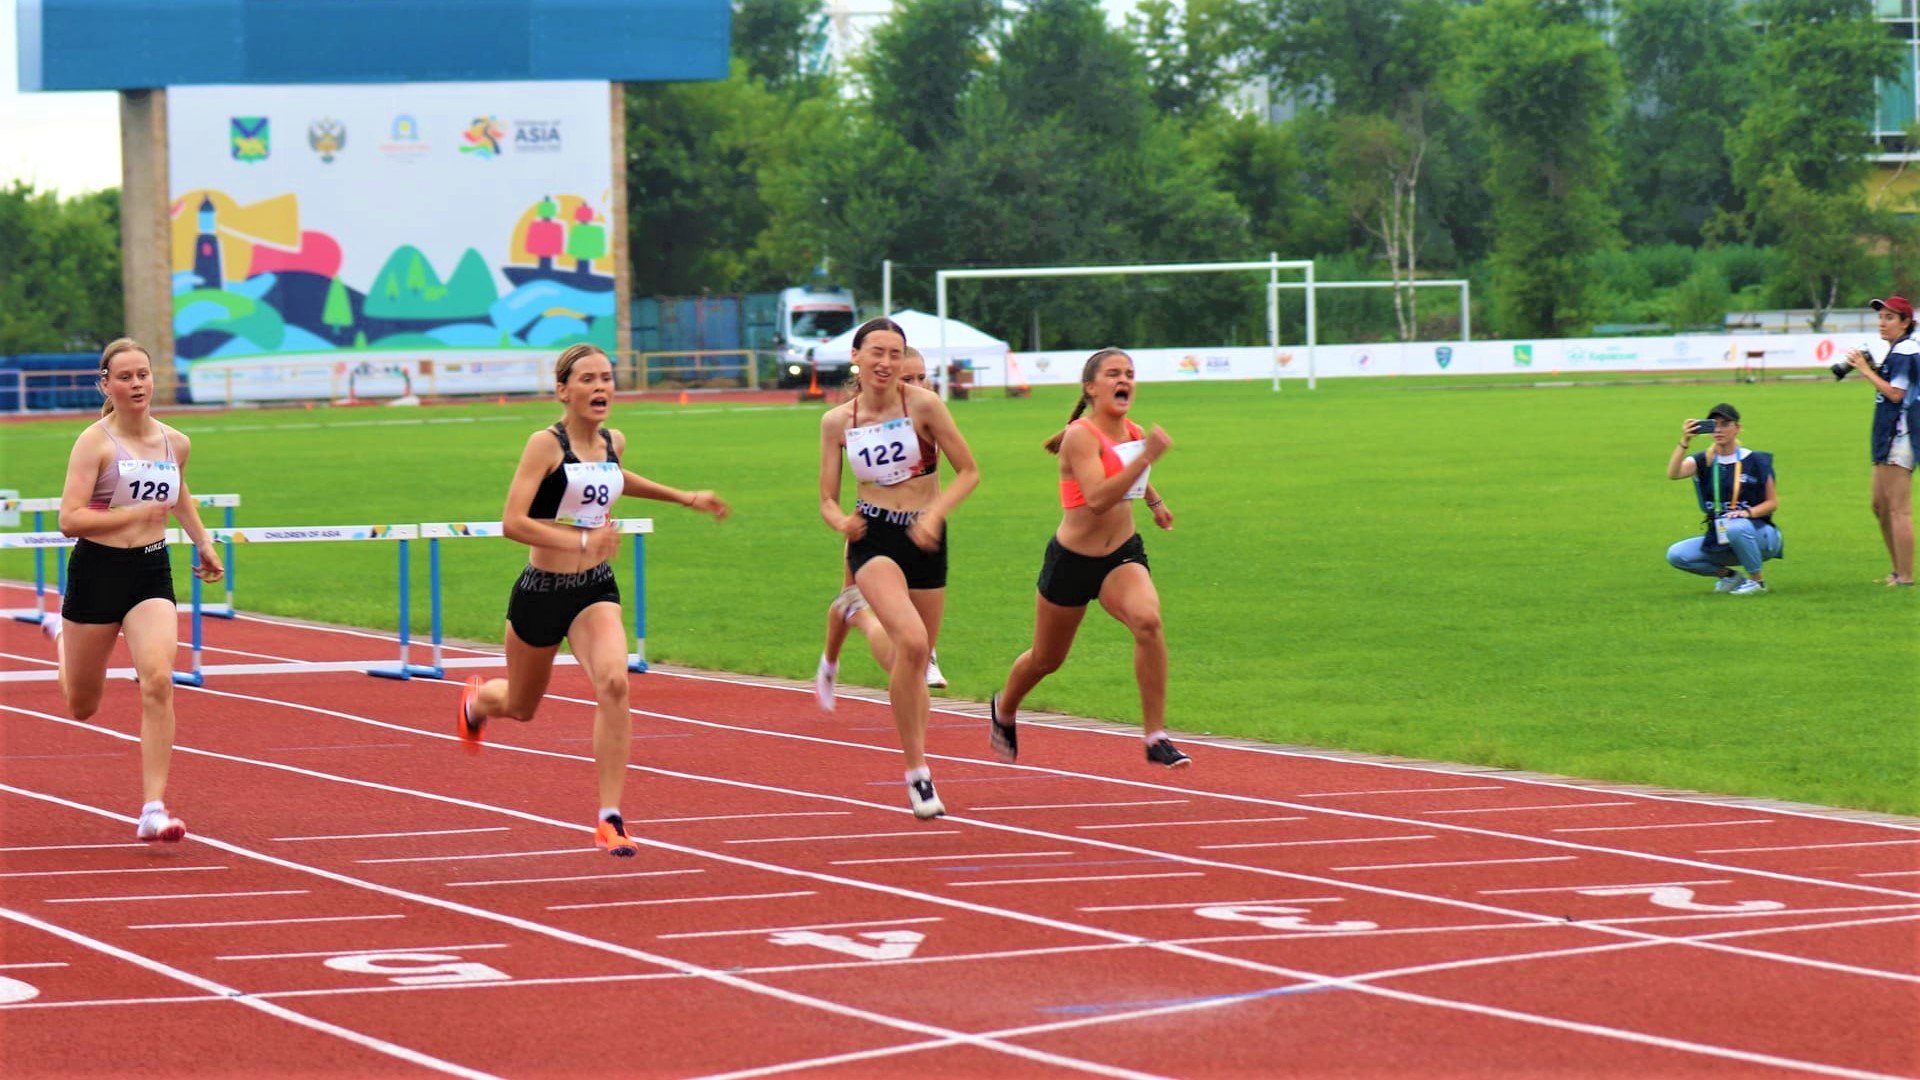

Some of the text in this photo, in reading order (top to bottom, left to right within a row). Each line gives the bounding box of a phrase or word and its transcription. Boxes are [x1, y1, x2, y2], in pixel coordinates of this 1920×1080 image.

[515, 127, 560, 142] ASIA
[858, 441, 906, 467] 122
[129, 480, 170, 502] 128
[580, 484, 609, 506] 98
[264, 529, 341, 540] CHILDREN OF ASIA
[144, 541, 163, 554] NIKE
[1575, 886, 1787, 912] 2
[1193, 905, 1378, 933] 3
[768, 930, 926, 961] 4
[323, 952, 513, 986] 5
